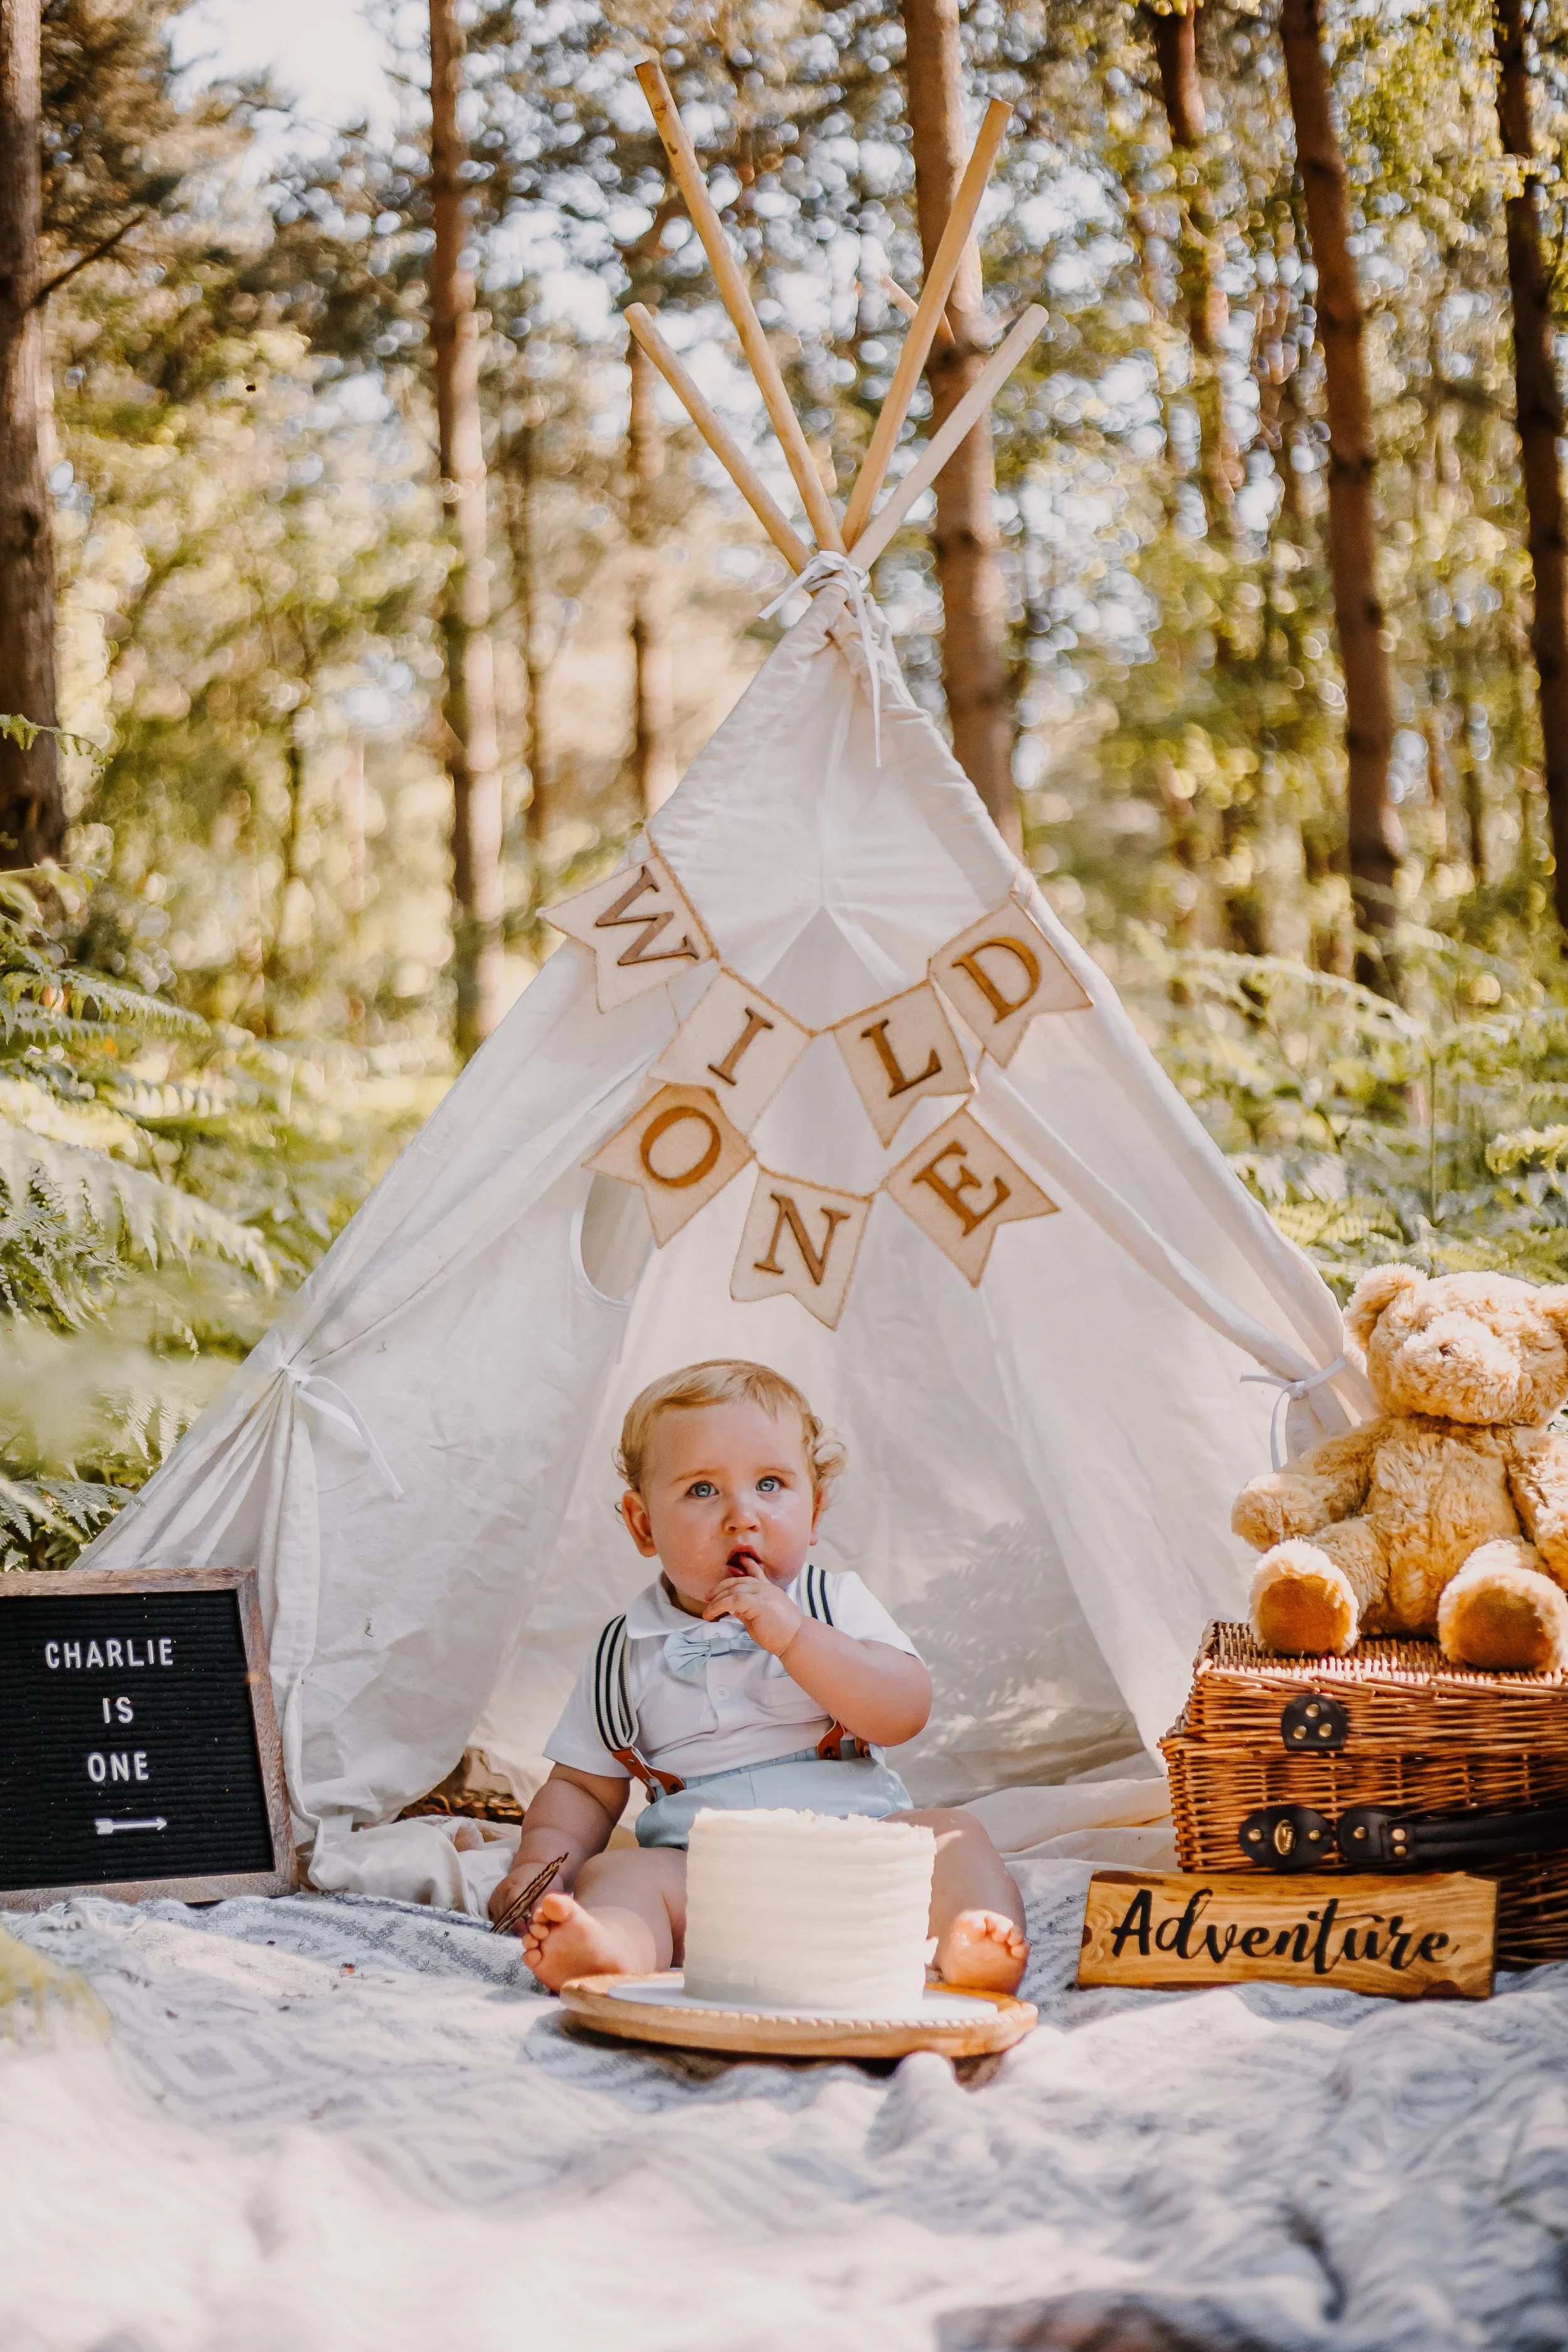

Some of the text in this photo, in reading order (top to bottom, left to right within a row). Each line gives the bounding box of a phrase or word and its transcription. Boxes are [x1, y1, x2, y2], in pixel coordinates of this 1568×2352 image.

[595, 864, 1041, 1099] WILD
[640, 1105, 1010, 1286] ONE
[45, 1638, 174, 1669] CHARLIE
[102, 1696, 134, 1724] IS
[87, 1751, 150, 1783] ONE
[1111, 1888, 1460, 1975] Adventure
